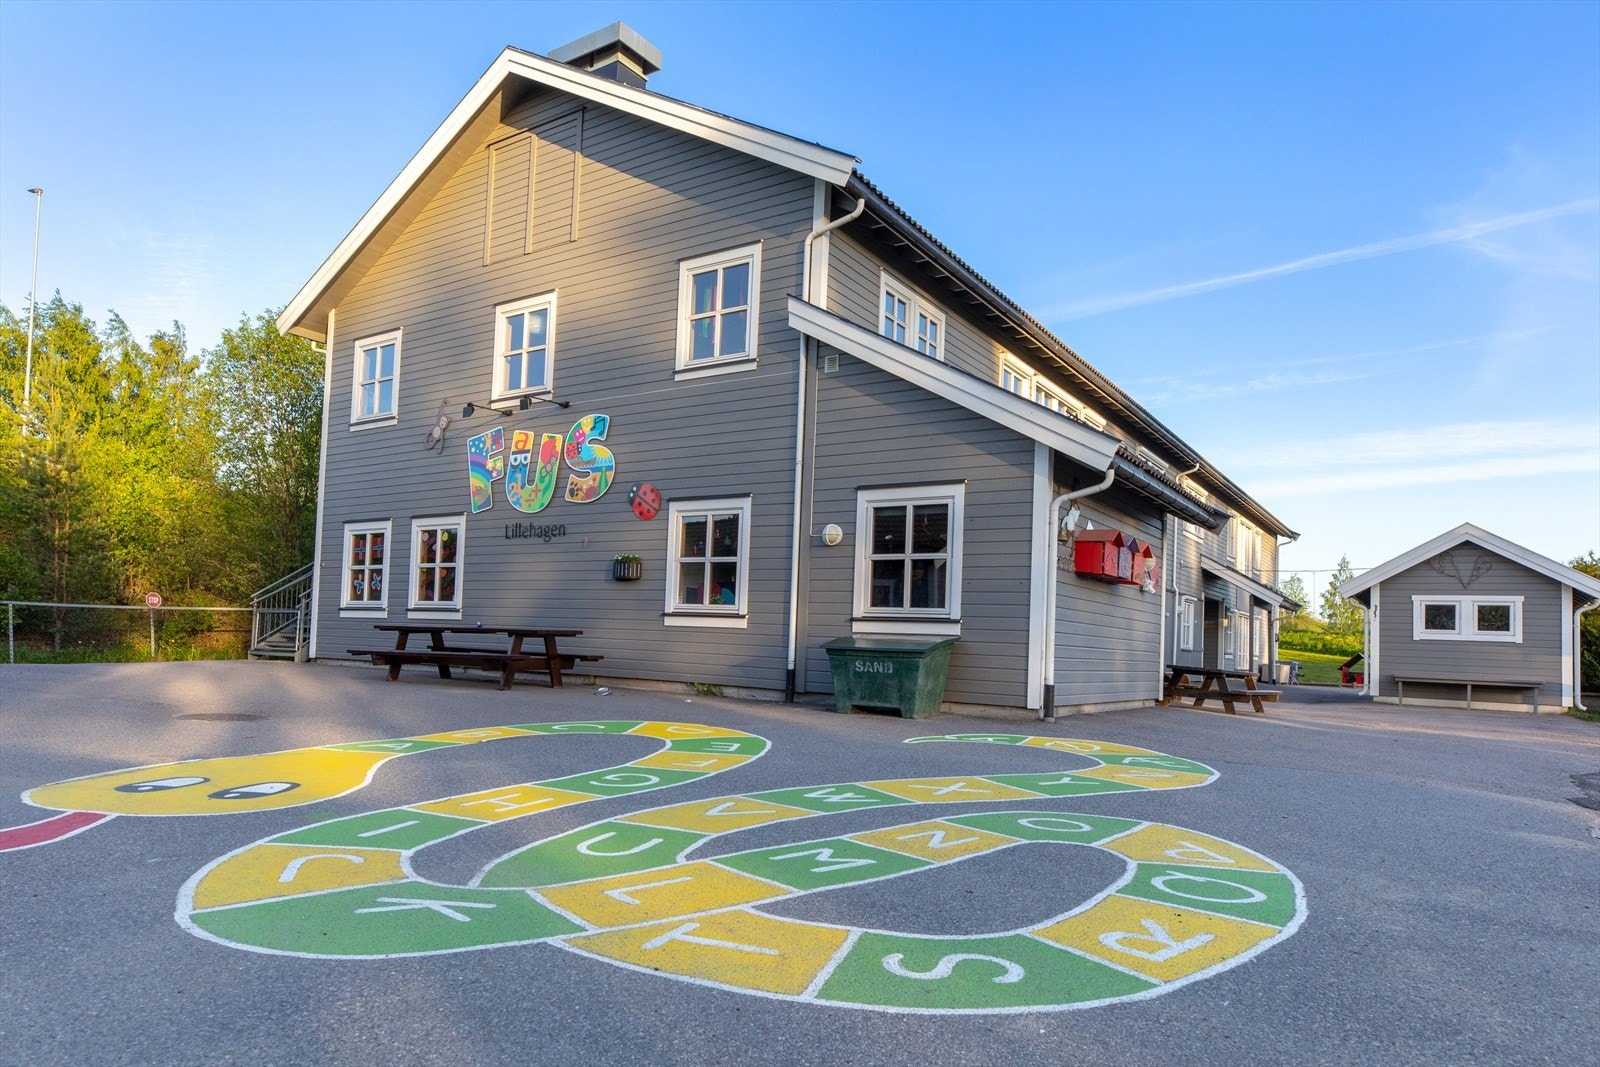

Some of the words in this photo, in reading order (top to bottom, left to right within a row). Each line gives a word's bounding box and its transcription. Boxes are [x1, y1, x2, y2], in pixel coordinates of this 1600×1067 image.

[467, 414, 615, 514] FUS
[505, 523, 566, 541] Lillehagen
[855, 660, 893, 674] SAND
[663, 724, 715, 734] D
[358, 742, 413, 751] A
[704, 741, 741, 752] E
[672, 758, 719, 768] F
[589, 773, 660, 787] G
[907, 782, 993, 795] X
[1038, 777, 1101, 785] Y
[460, 793, 554, 812] H
[704, 802, 777, 817] V
[1017, 817, 1094, 832] O
[576, 831, 664, 857] U
[896, 830, 981, 849] N
[768, 847, 878, 873] M
[603, 876, 694, 905] L
[355, 897, 497, 922] K
[640, 922, 779, 955] T
[1098, 918, 1216, 963] R
[882, 952, 1026, 985] S
